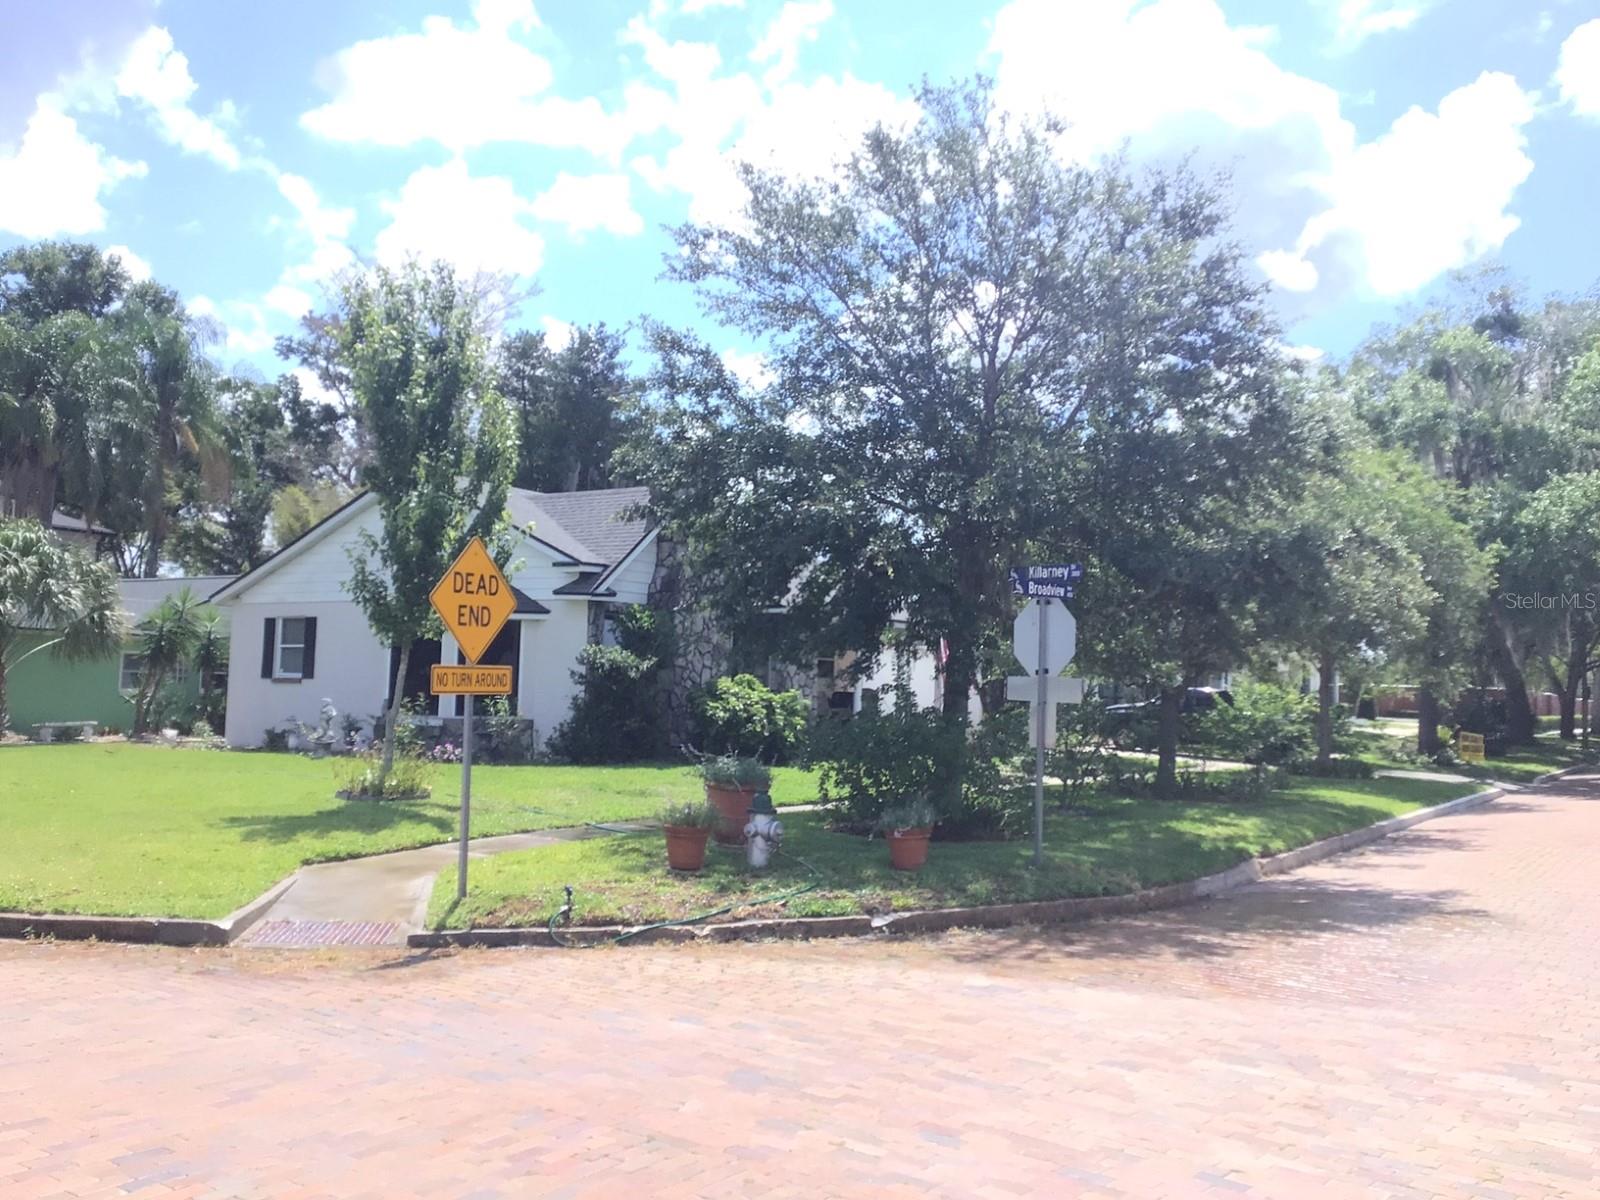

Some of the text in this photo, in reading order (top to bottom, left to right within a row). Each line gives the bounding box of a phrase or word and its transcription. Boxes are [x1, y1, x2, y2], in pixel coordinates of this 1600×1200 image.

[1028, 566, 1069, 580] Killarney
[453, 571, 499, 596] DEAD
[1028, 581, 1065, 597] Broadview
[458, 605, 491, 627] END
[436, 672, 508, 688] NO TURN AROUND
